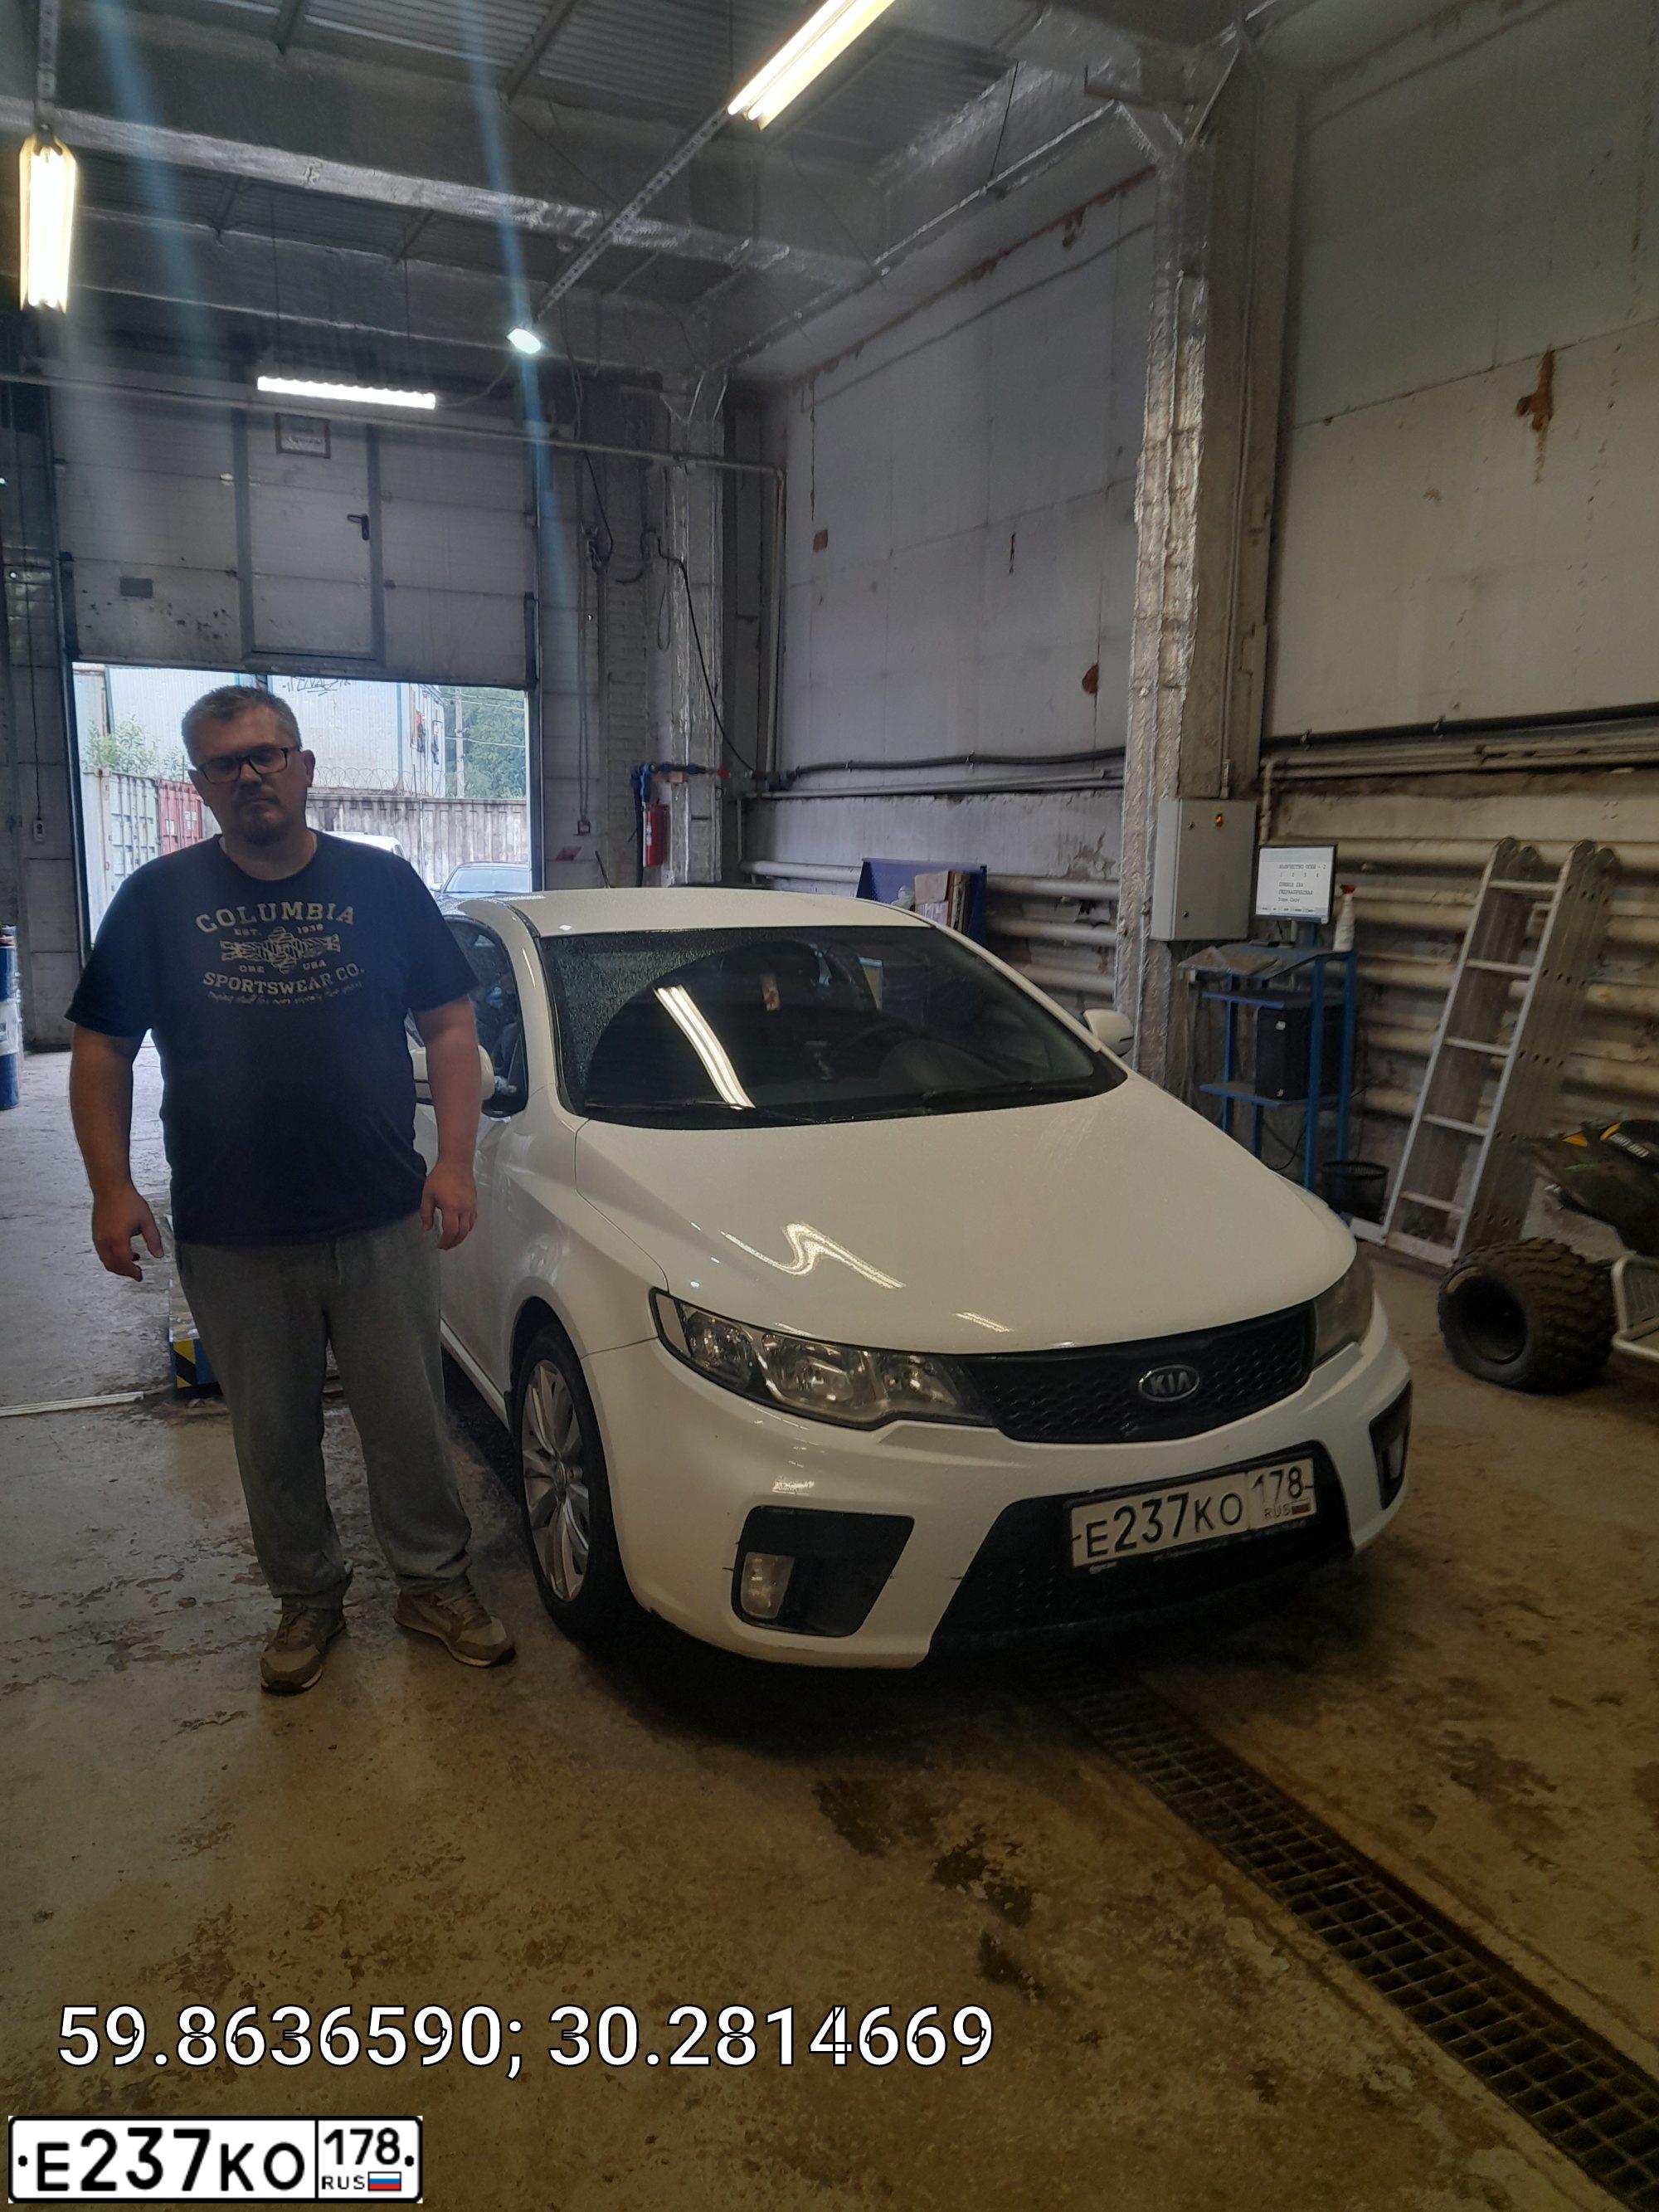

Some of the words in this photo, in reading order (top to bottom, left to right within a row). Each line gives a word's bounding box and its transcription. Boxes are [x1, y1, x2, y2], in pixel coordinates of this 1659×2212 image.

[195, 901, 355, 933] COLUMBIA
[202, 971, 332, 996] SPORTSWEAR
[335, 962, 365, 981] CO.
[1150, 1370, 1194, 1397] KIA
[1252, 1466, 1303, 1503] 178
[1264, 1503, 1291, 1520] RUS
